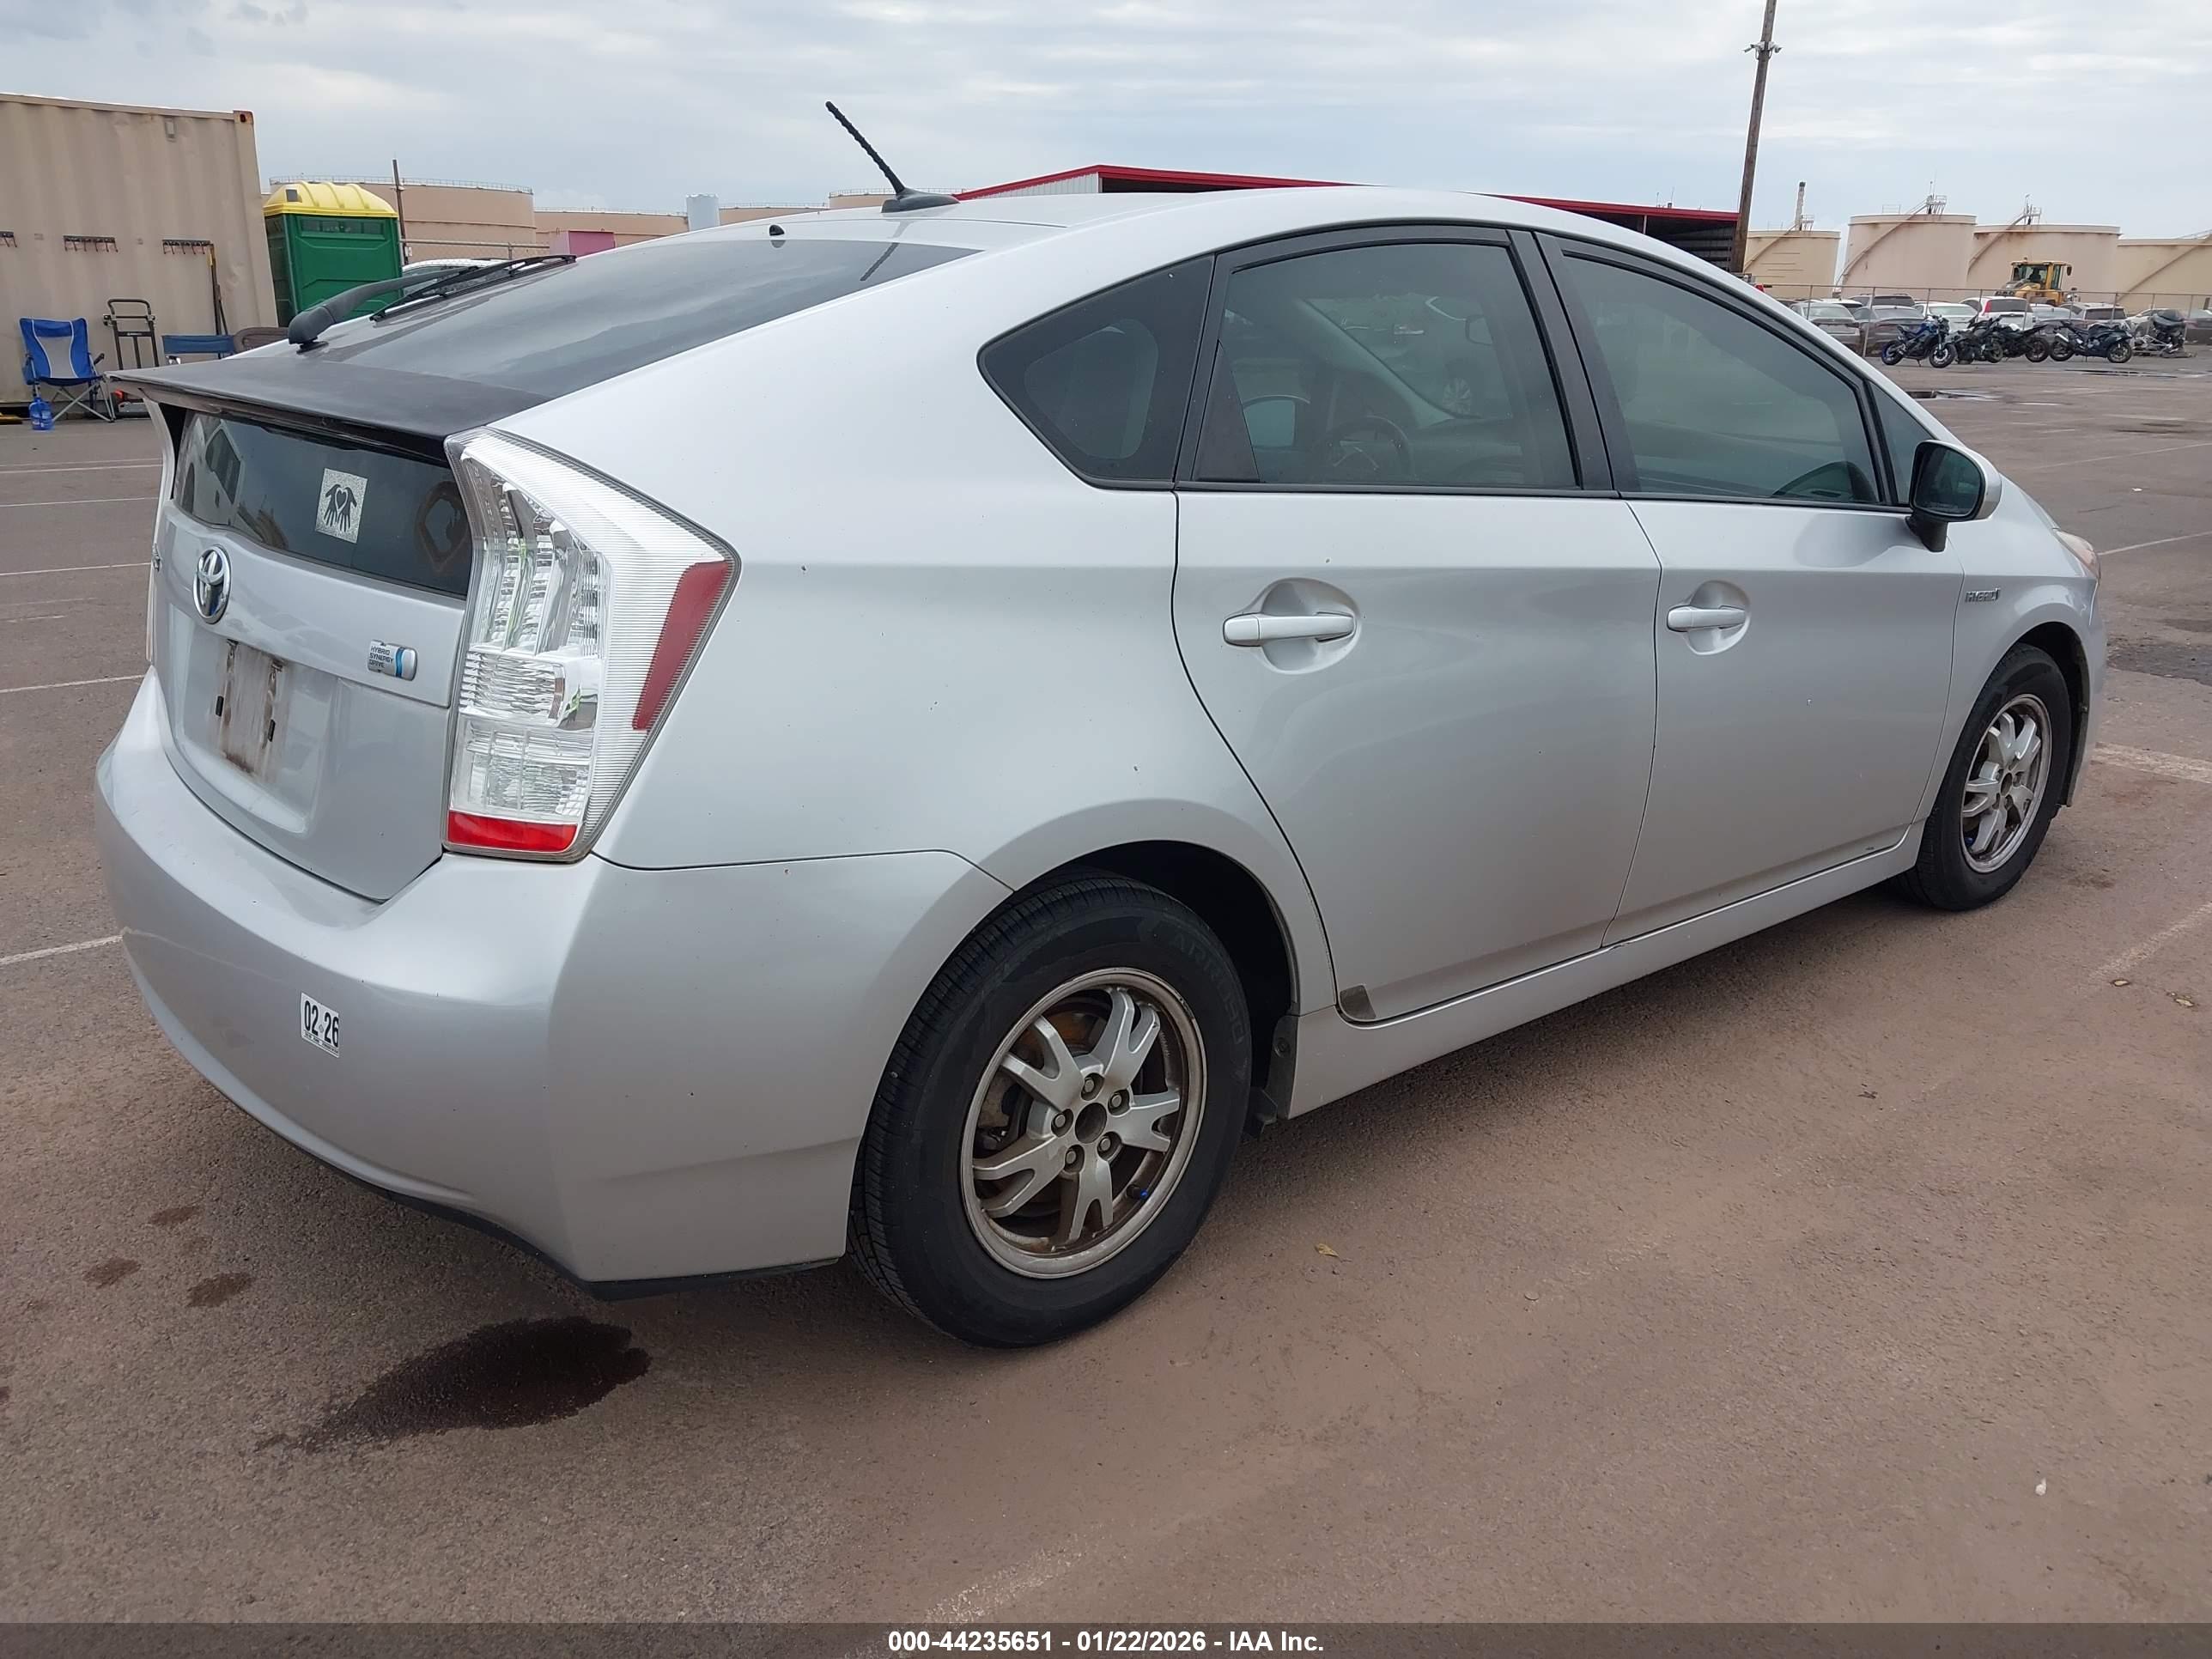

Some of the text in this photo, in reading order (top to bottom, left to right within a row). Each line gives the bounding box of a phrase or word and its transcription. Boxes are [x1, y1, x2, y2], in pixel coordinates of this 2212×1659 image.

[370, 645, 391, 656] HYBRID
[369, 652, 393, 664] SYNERGY
[369, 659, 386, 668] DRIVE
[304, 1000, 319, 1036] 02
[324, 1012, 339, 1048] 26
